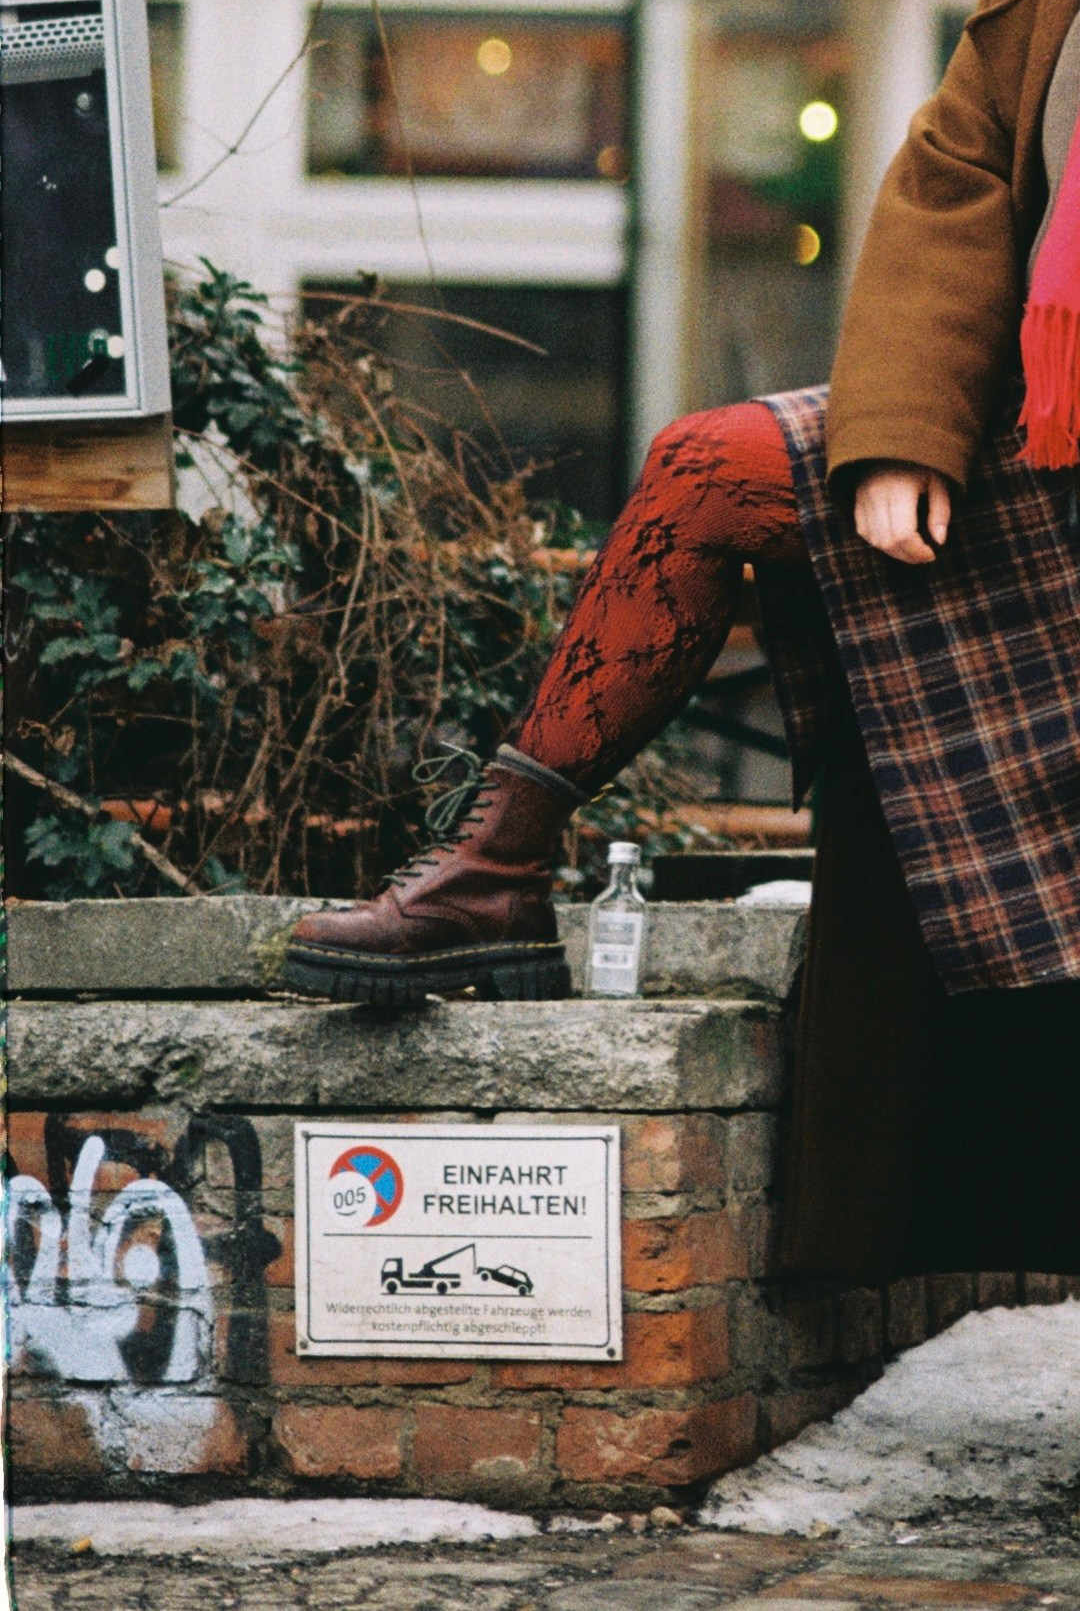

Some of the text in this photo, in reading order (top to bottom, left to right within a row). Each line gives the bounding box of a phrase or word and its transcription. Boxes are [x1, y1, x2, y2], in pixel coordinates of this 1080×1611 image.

[443, 1164, 568, 1186] EINFAHRT
[333, 1187, 366, 1210] 005
[423, 1194, 587, 1216] FREIHALTEN!
[326, 1302, 592, 1319] Widerrechtlich abgestellte Fahrzeuge werden
[371, 1320, 460, 1336] kostenpflichtig
